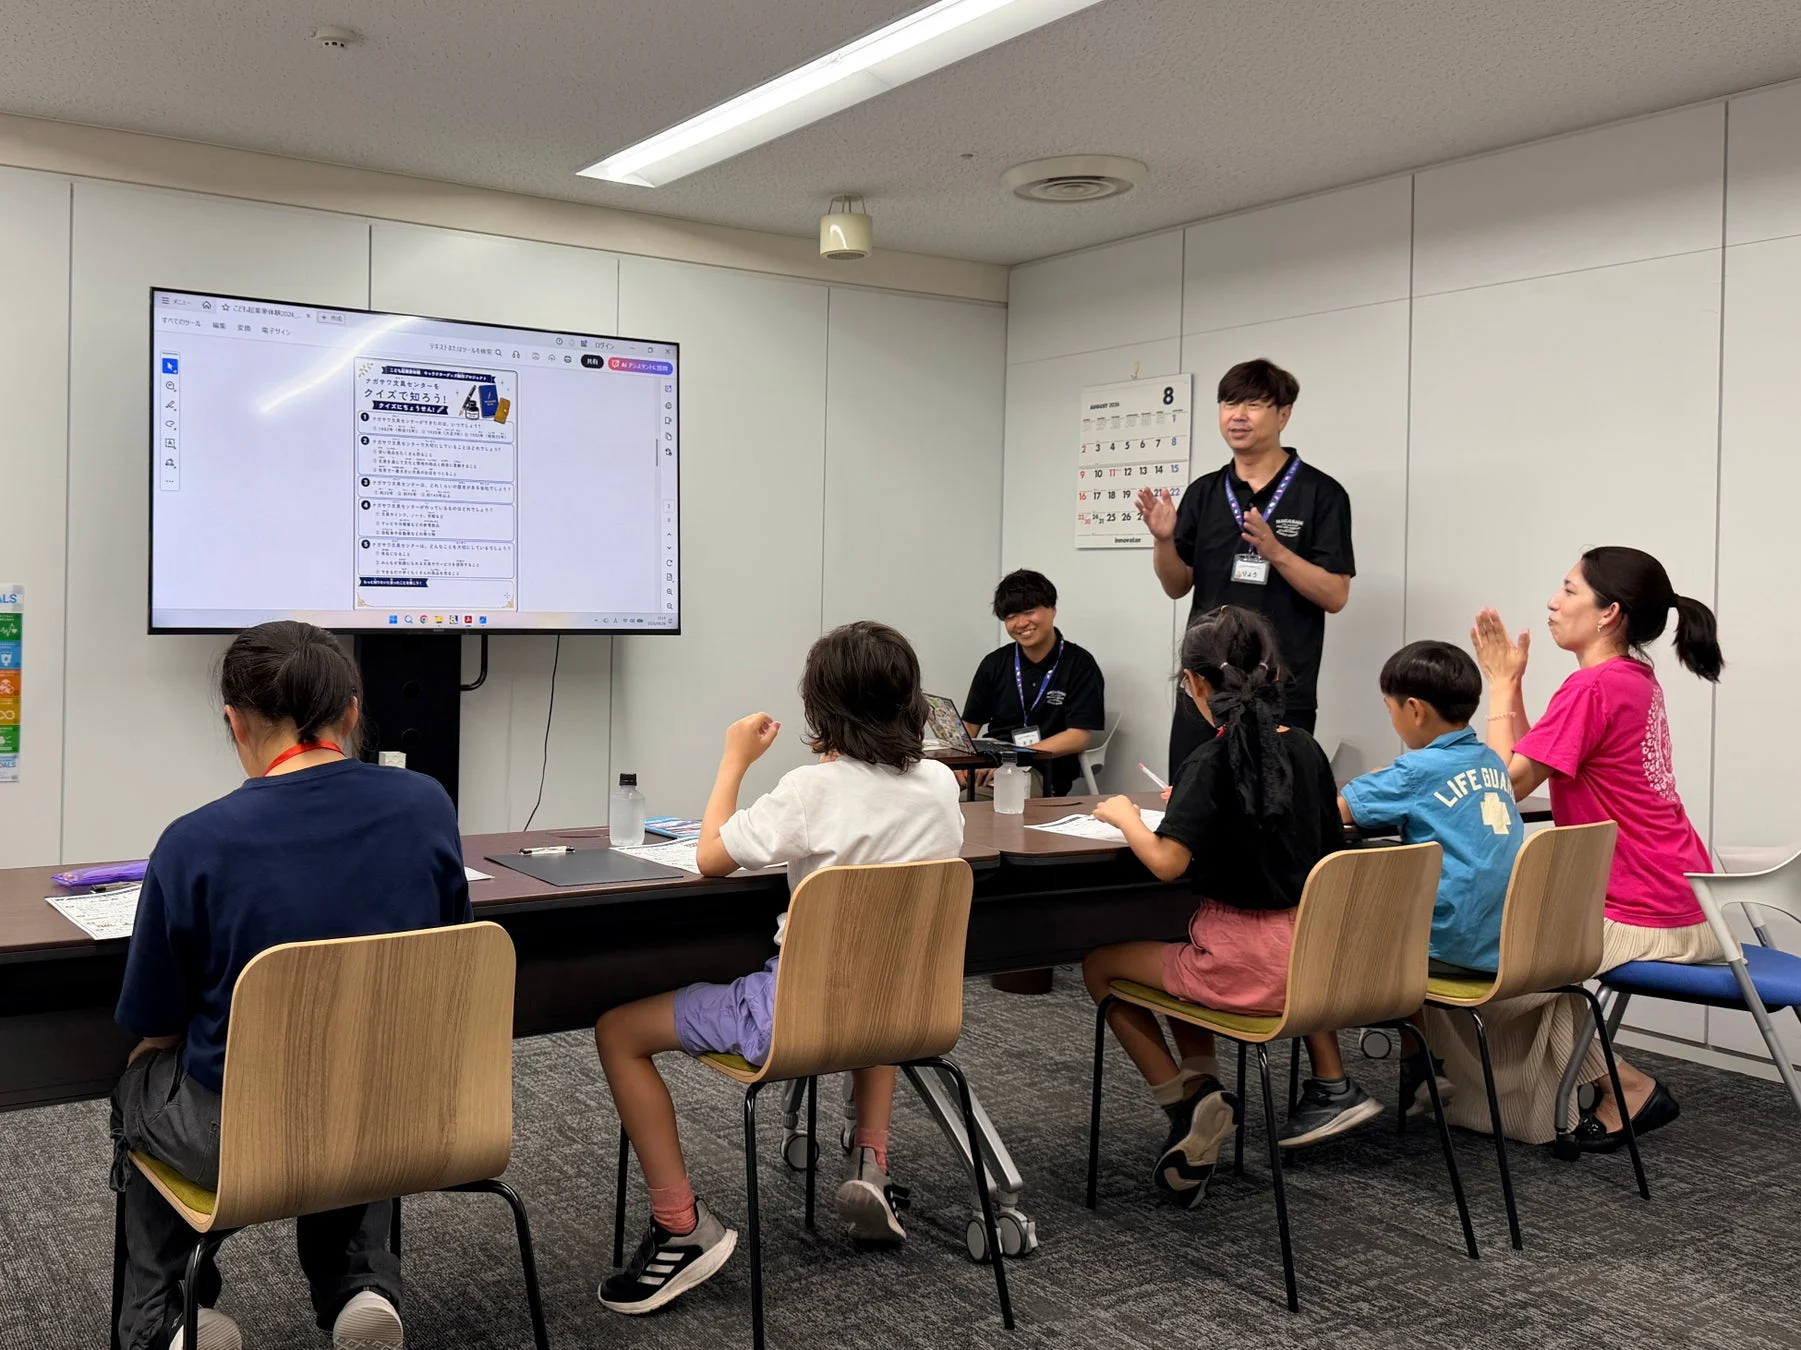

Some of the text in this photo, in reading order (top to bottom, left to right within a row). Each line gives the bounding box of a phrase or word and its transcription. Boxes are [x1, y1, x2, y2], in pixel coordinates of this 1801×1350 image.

[162, 316, 202, 327] すべてのツール
[262, 326, 290, 336] 電子サイン
[594, 342, 614, 350] ログイン
[366, 378, 440, 390] ナガサワ文具センターを
[1163, 386, 1174, 405] 8
[1172, 414, 1176, 422] 1
[1082, 444, 1086, 453] 2
[1156, 439, 1160, 447] 7
[1172, 437, 1177, 446] 8
[1080, 464, 1179, 479] 9 10 11 12 13 14 15
[1079, 492, 1086, 500] 16
[1094, 492, 1100, 500] 17
[1123, 490, 1131, 498] 19
[1170, 488, 1180, 496] 22
[1107, 513, 1116, 522] 25
[1122, 513, 1131, 521] 26
[0, 594, 17, 604] LS
[1433, 769, 1482, 808] LIFE
